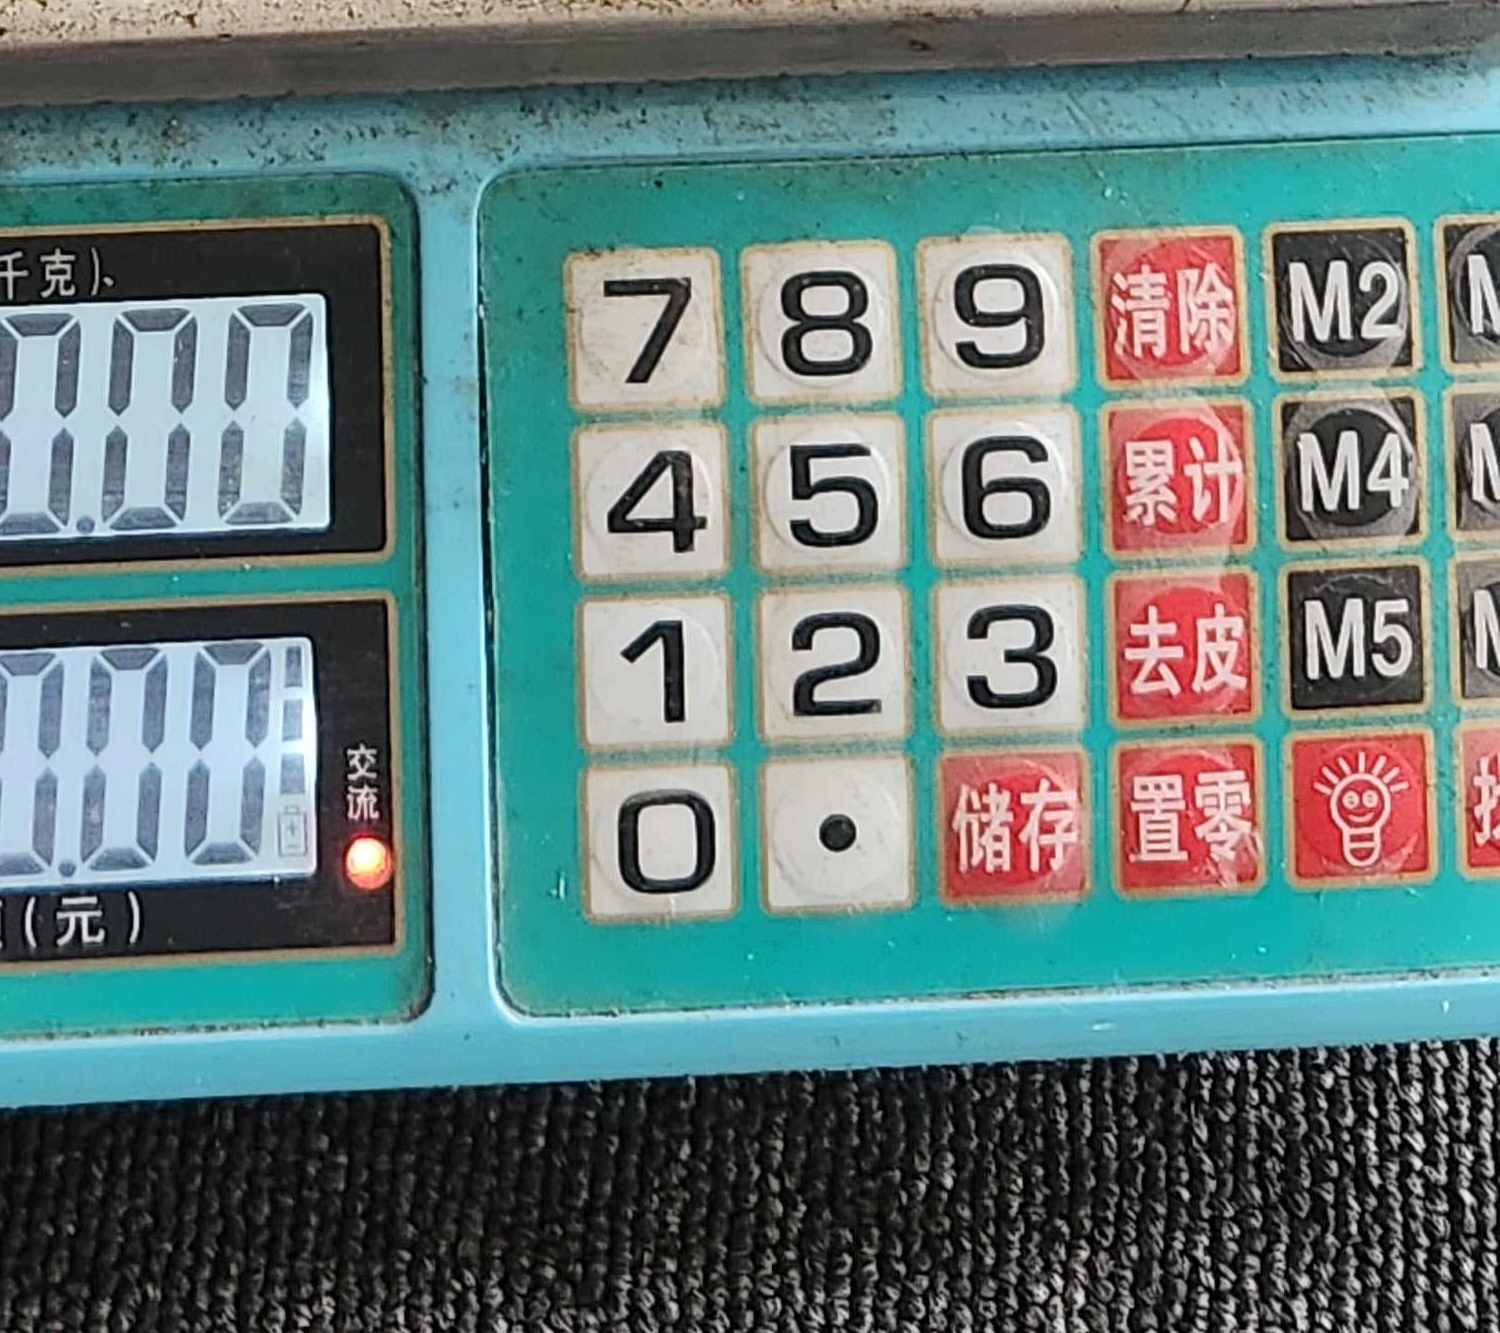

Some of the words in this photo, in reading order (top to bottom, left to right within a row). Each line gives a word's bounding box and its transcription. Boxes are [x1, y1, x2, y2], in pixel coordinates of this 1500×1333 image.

[603, 277, 692, 385] 7
[780, 270, 872, 377] 8
[953, 263, 1044, 369] 9
[1111, 265, 1234, 359] 清除
[1288, 259, 1403, 342] M2
[606, 449, 708, 553] 4
[789, 444, 877, 549] 5
[962, 434, 1052, 541] 6
[1123, 437, 1242, 526] 累计
[1298, 429, 1409, 512] M4
[619, 620, 686, 723] 1
[793, 612, 882, 716] 2
[965, 604, 1059, 709] 3
[1123, 604, 1248, 698] 去皮
[1304, 598, 1412, 680] M5
[347, 743, 380, 820] 交流
[953, 781, 1078, 875] 储存
[1129, 768, 1256, 866] 置零
[617, 788, 716, 894] 0
